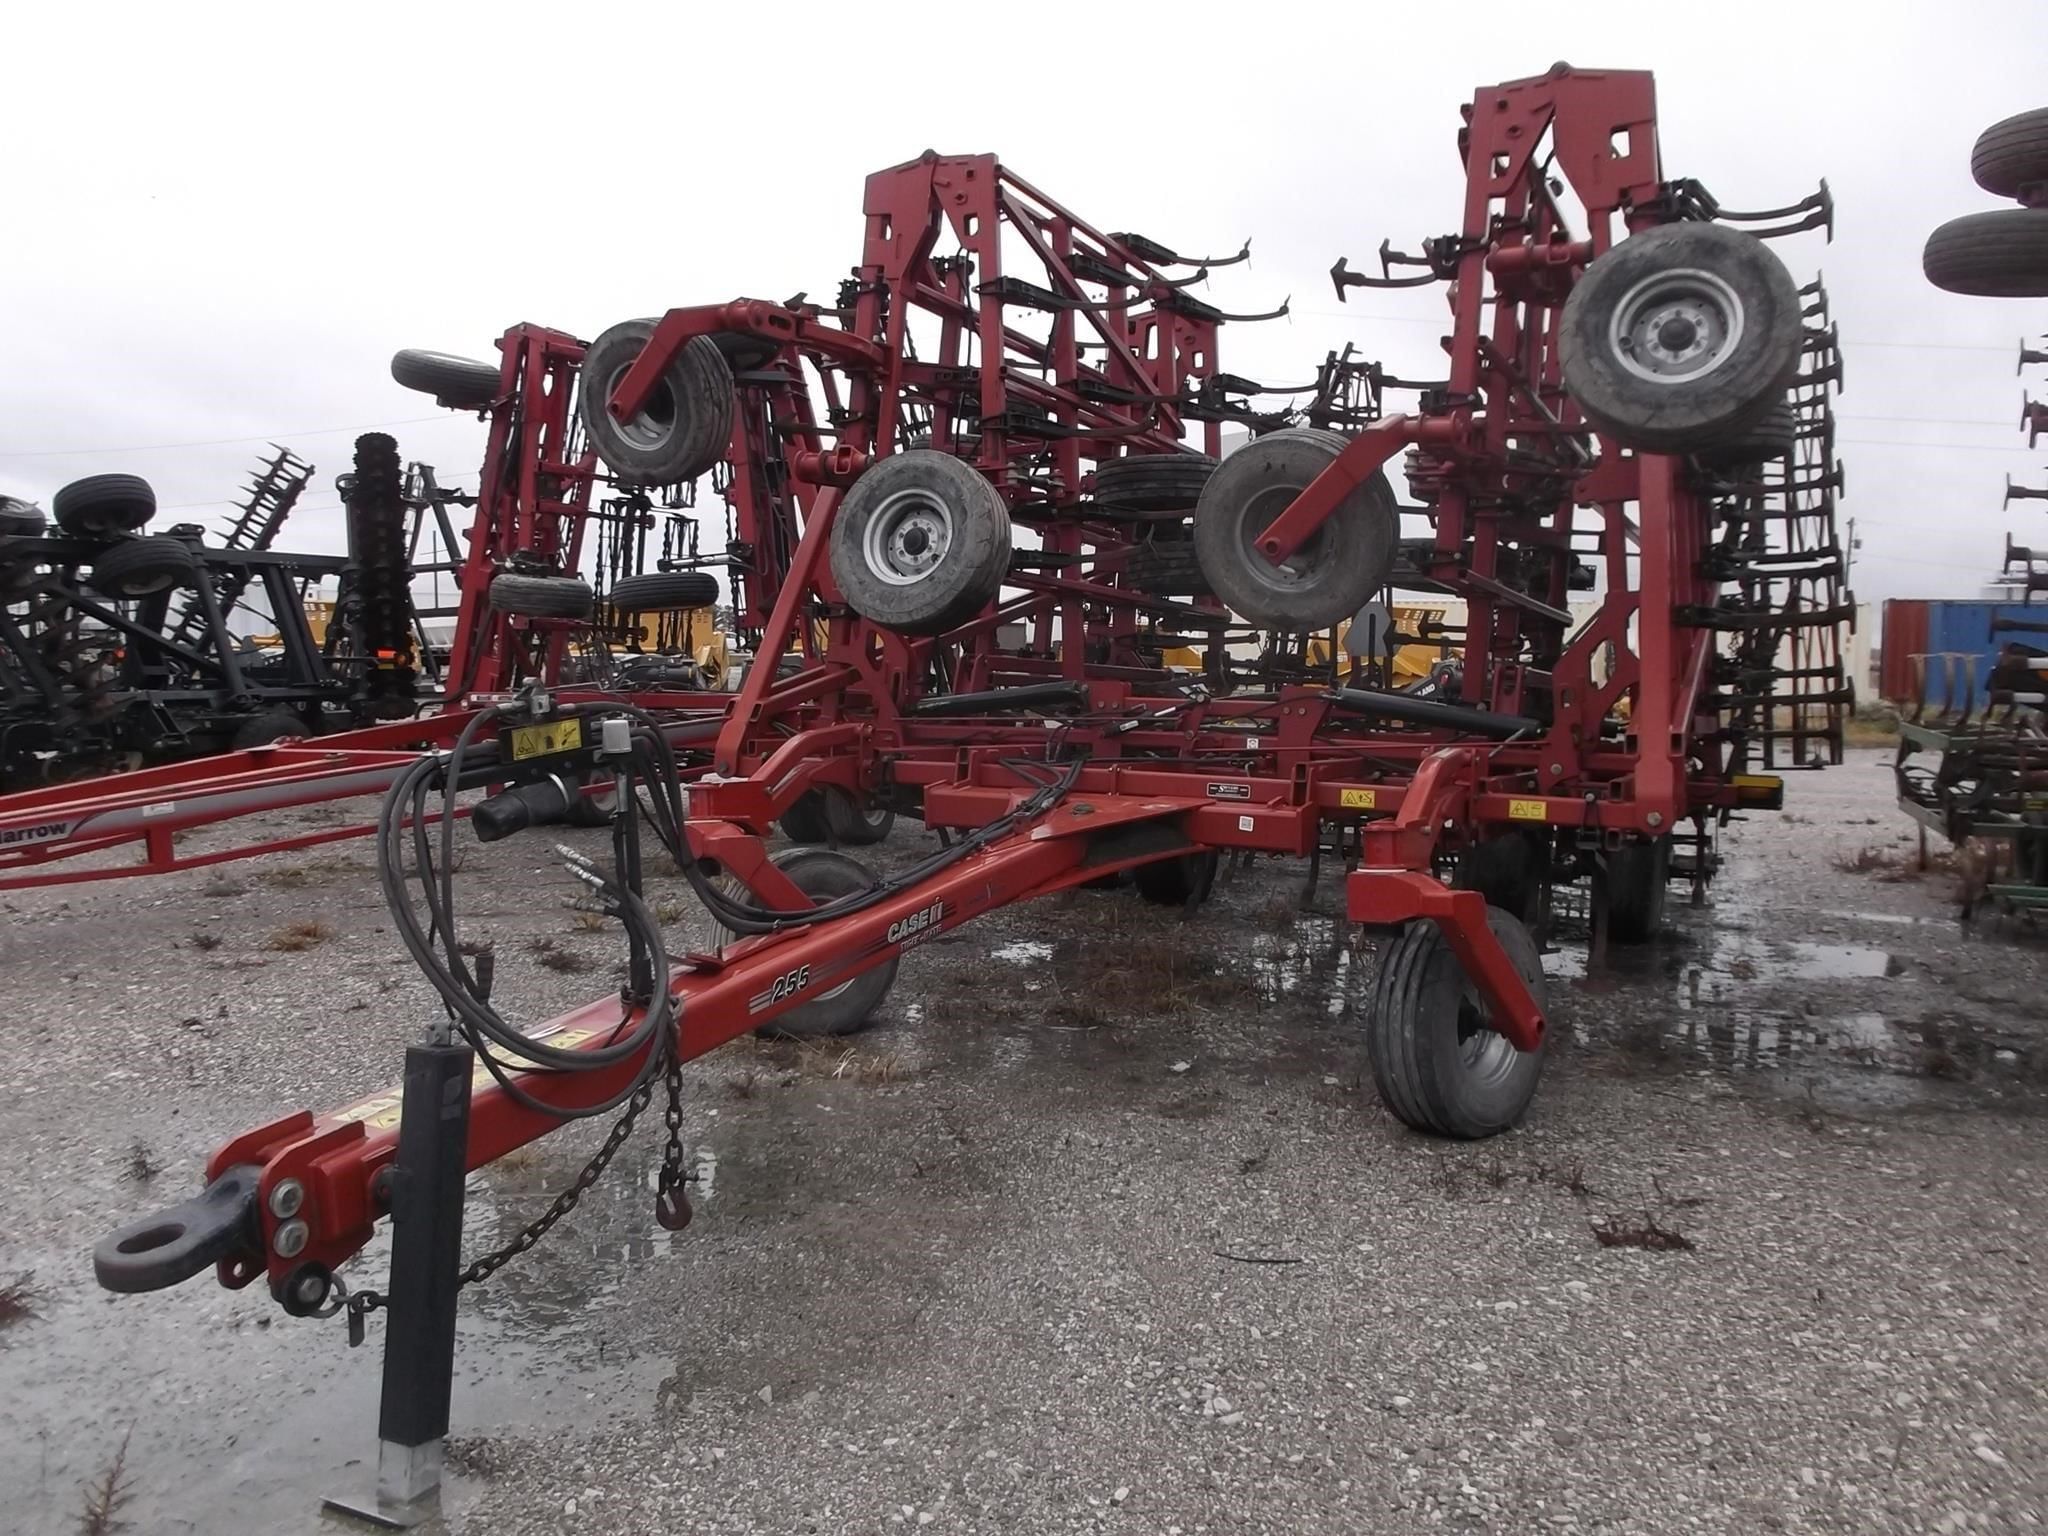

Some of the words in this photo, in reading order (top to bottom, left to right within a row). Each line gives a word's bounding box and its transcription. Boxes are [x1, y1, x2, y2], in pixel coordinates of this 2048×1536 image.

[0, 823, 68, 844] arrow
[887, 908, 930, 944] CASE
[771, 963, 811, 1005] 255
